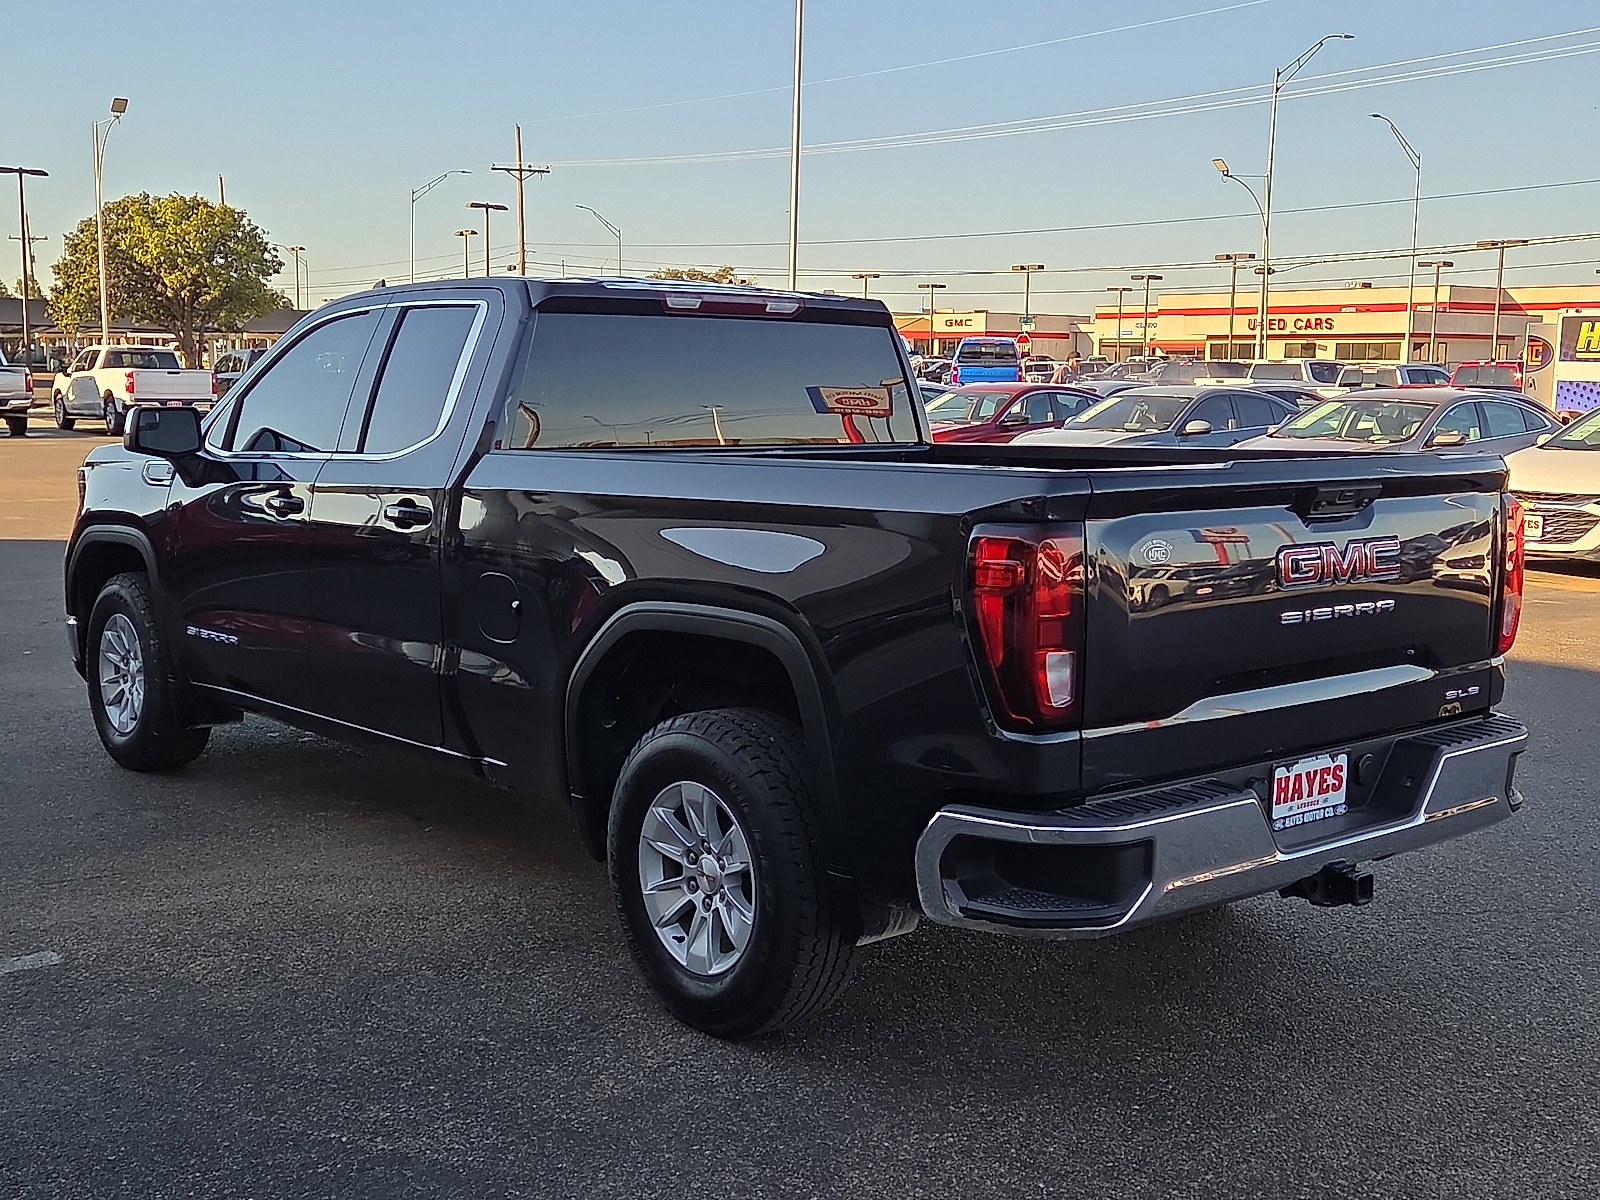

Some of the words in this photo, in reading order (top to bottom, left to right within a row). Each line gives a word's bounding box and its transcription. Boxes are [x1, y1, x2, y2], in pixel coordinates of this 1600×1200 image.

[945, 318, 973, 327] GMC
[1247, 318, 1288, 331] UED
[1293, 317, 1335, 331] CARS
[1275, 534, 1402, 591] GMC
[1279, 599, 1396, 626] SIERRA
[186, 625, 239, 646] SIERRA
[1275, 764, 1344, 806] HAYES
